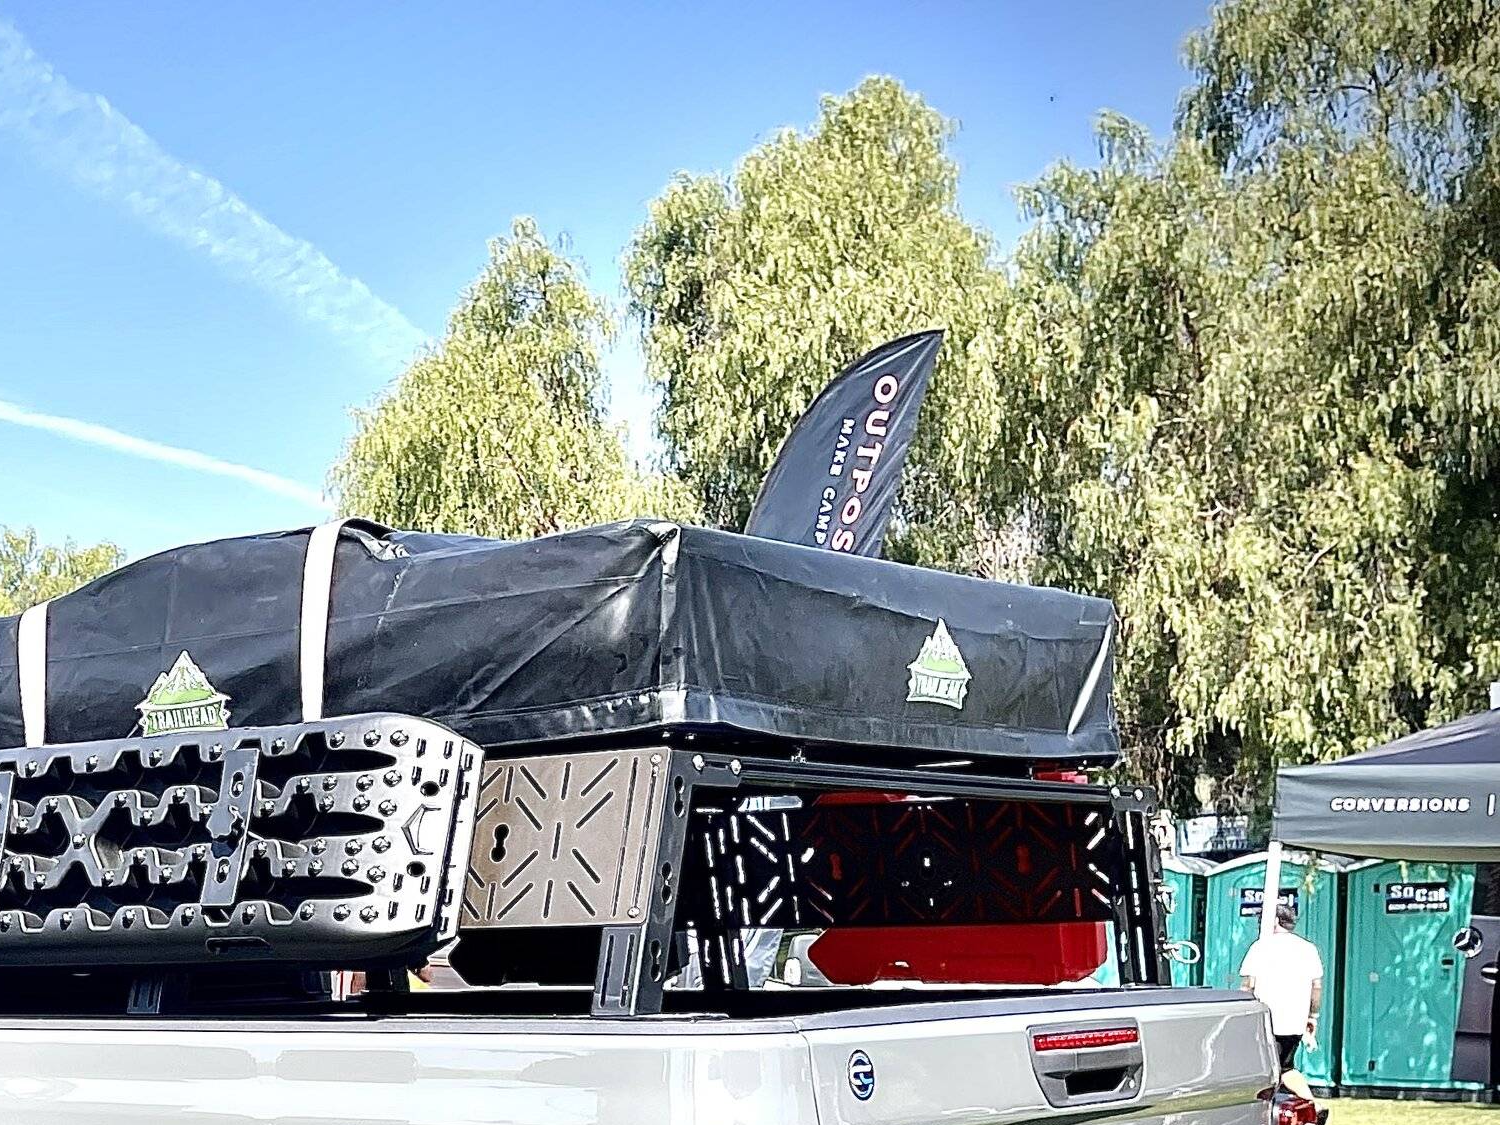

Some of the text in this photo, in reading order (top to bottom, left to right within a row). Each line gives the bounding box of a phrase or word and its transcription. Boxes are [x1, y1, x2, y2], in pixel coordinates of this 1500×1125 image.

[814, 418, 855, 545] MAKE CAMP
[830, 374, 899, 551] OUTPOS
[149, 702, 218, 730] TRAILHEAD
[1330, 797, 1470, 813] CONVERSIONS
